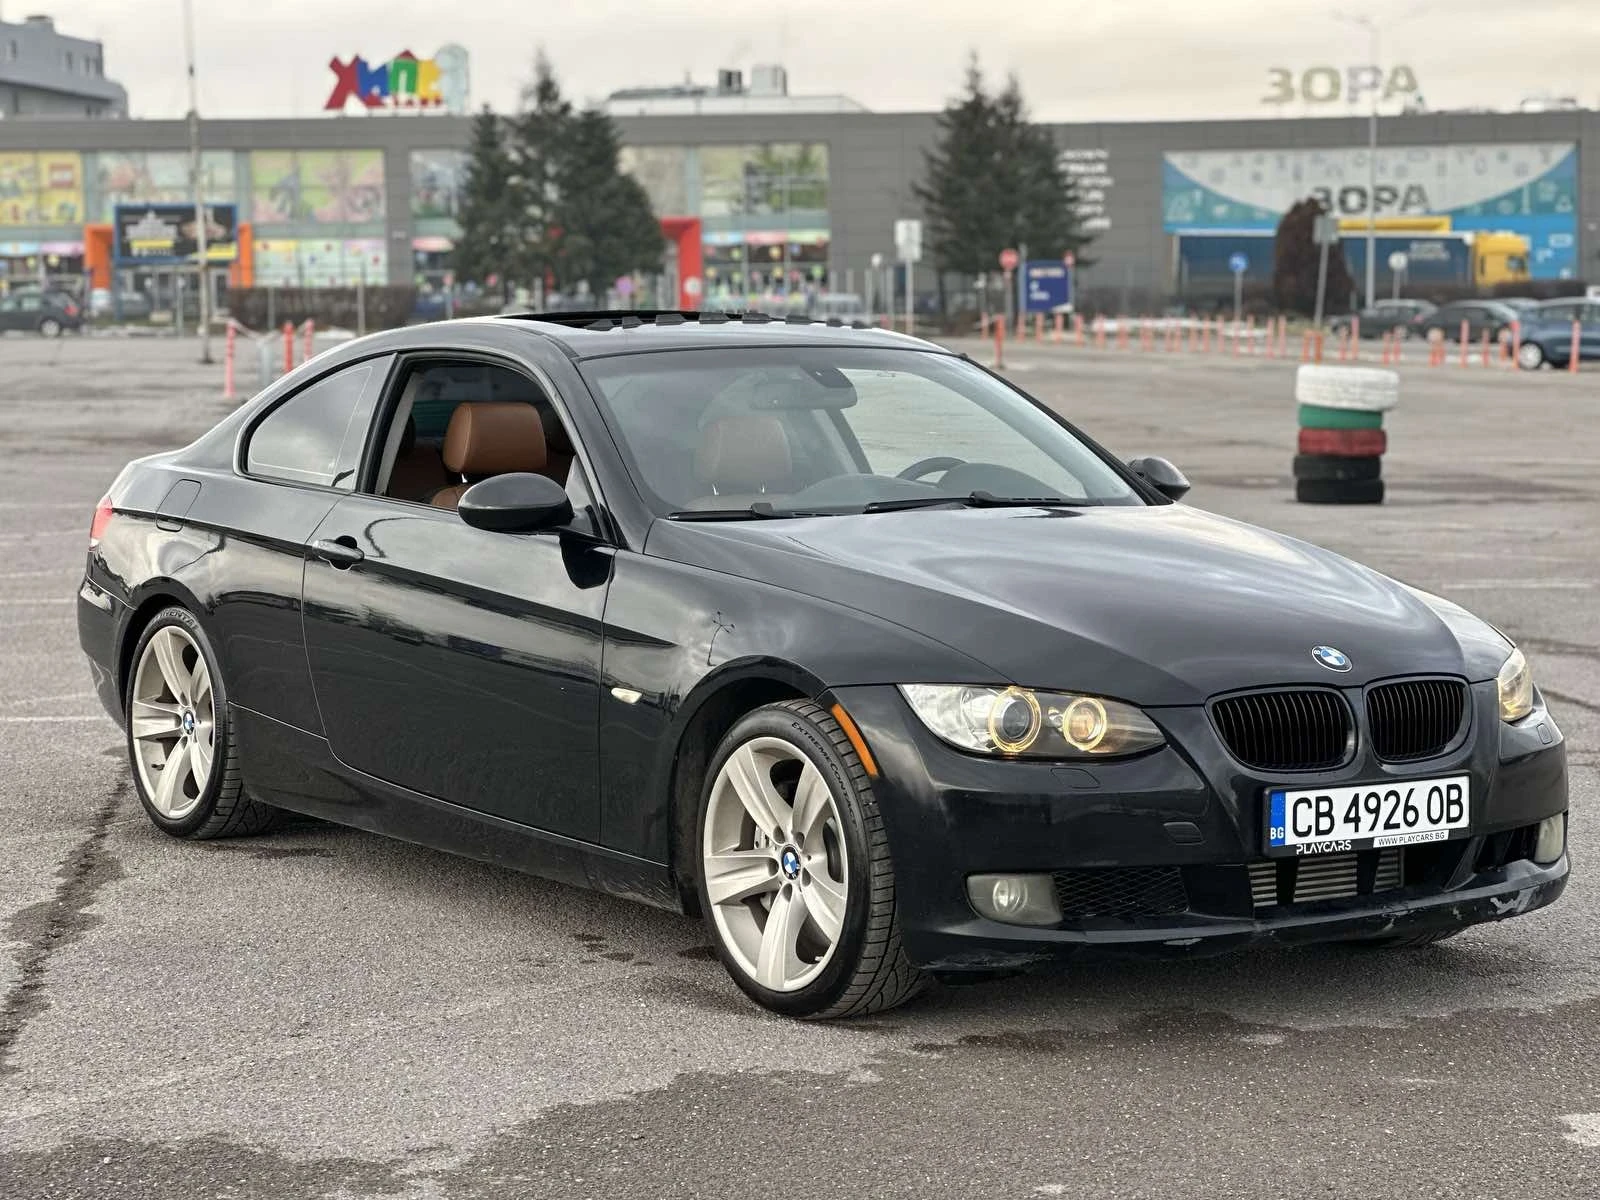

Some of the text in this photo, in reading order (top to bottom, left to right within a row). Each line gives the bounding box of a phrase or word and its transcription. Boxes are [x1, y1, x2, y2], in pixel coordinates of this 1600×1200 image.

[1260, 66, 1418, 104] ЗОРА
[1292, 784, 1464, 837] CB 4926 OB
[1270, 827, 1284, 840] BG
[1296, 840, 1352, 855] PLAYCARS
